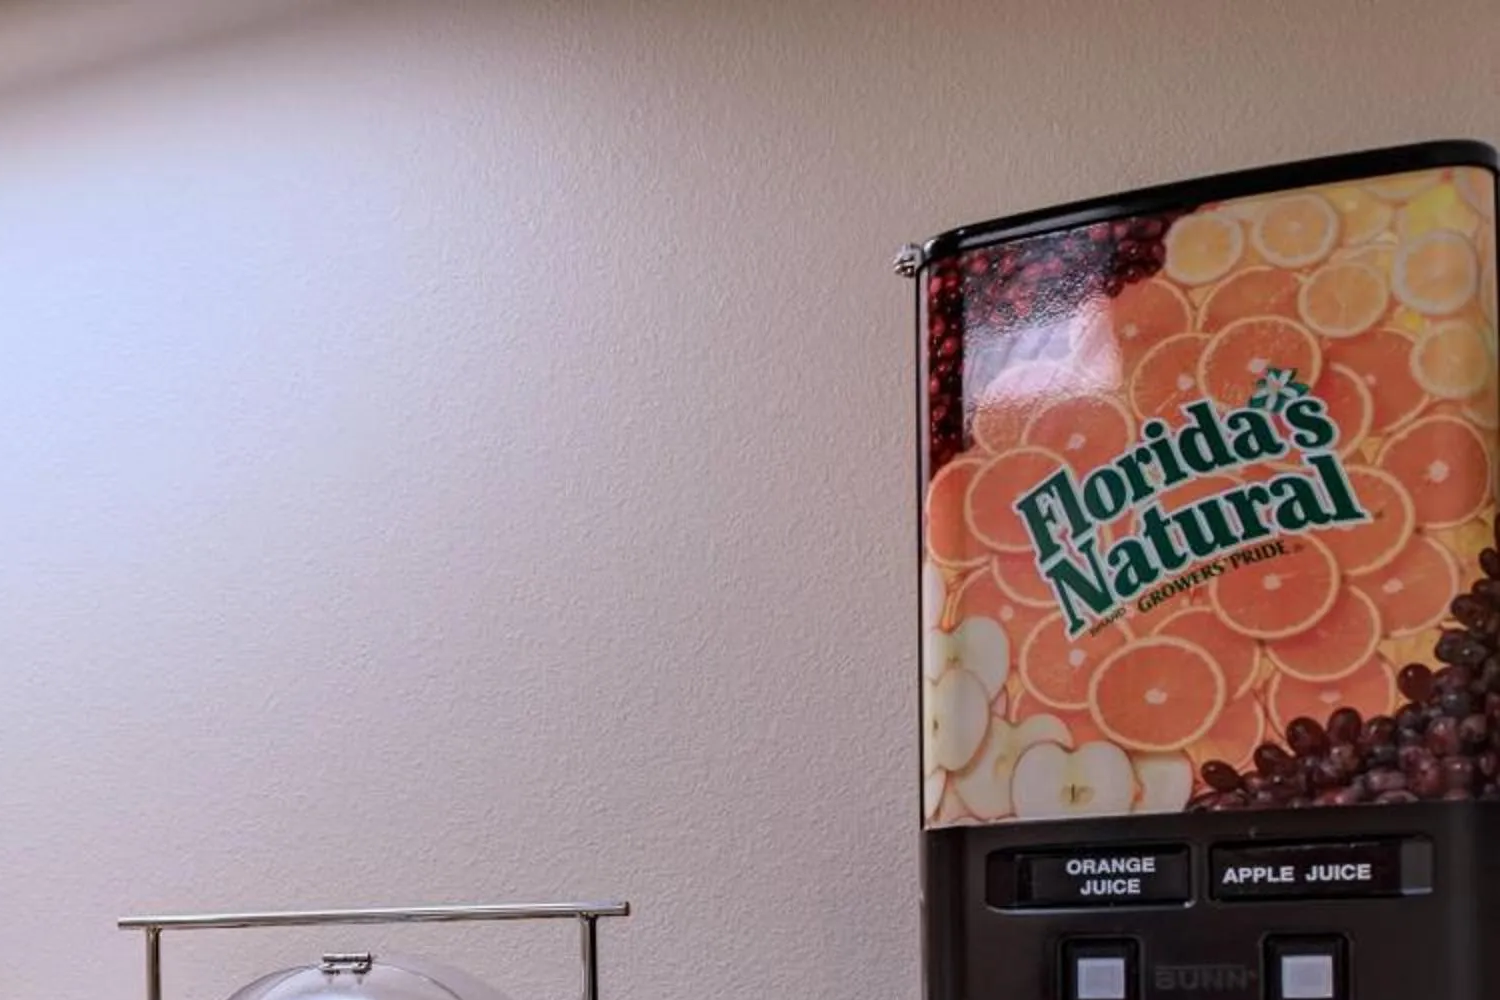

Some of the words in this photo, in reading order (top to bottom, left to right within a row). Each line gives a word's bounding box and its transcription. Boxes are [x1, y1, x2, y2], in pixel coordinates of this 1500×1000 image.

[1015, 394, 1338, 563] Florida's
[1045, 453, 1368, 636] Natural
[1229, 540, 1289, 571] PRIDE
[1065, 857, 1156, 876] ORANGE
[1222, 866, 1295, 885] APPLE
[1305, 863, 1372, 883] JUICE
[1080, 878, 1141, 896] JUICE
